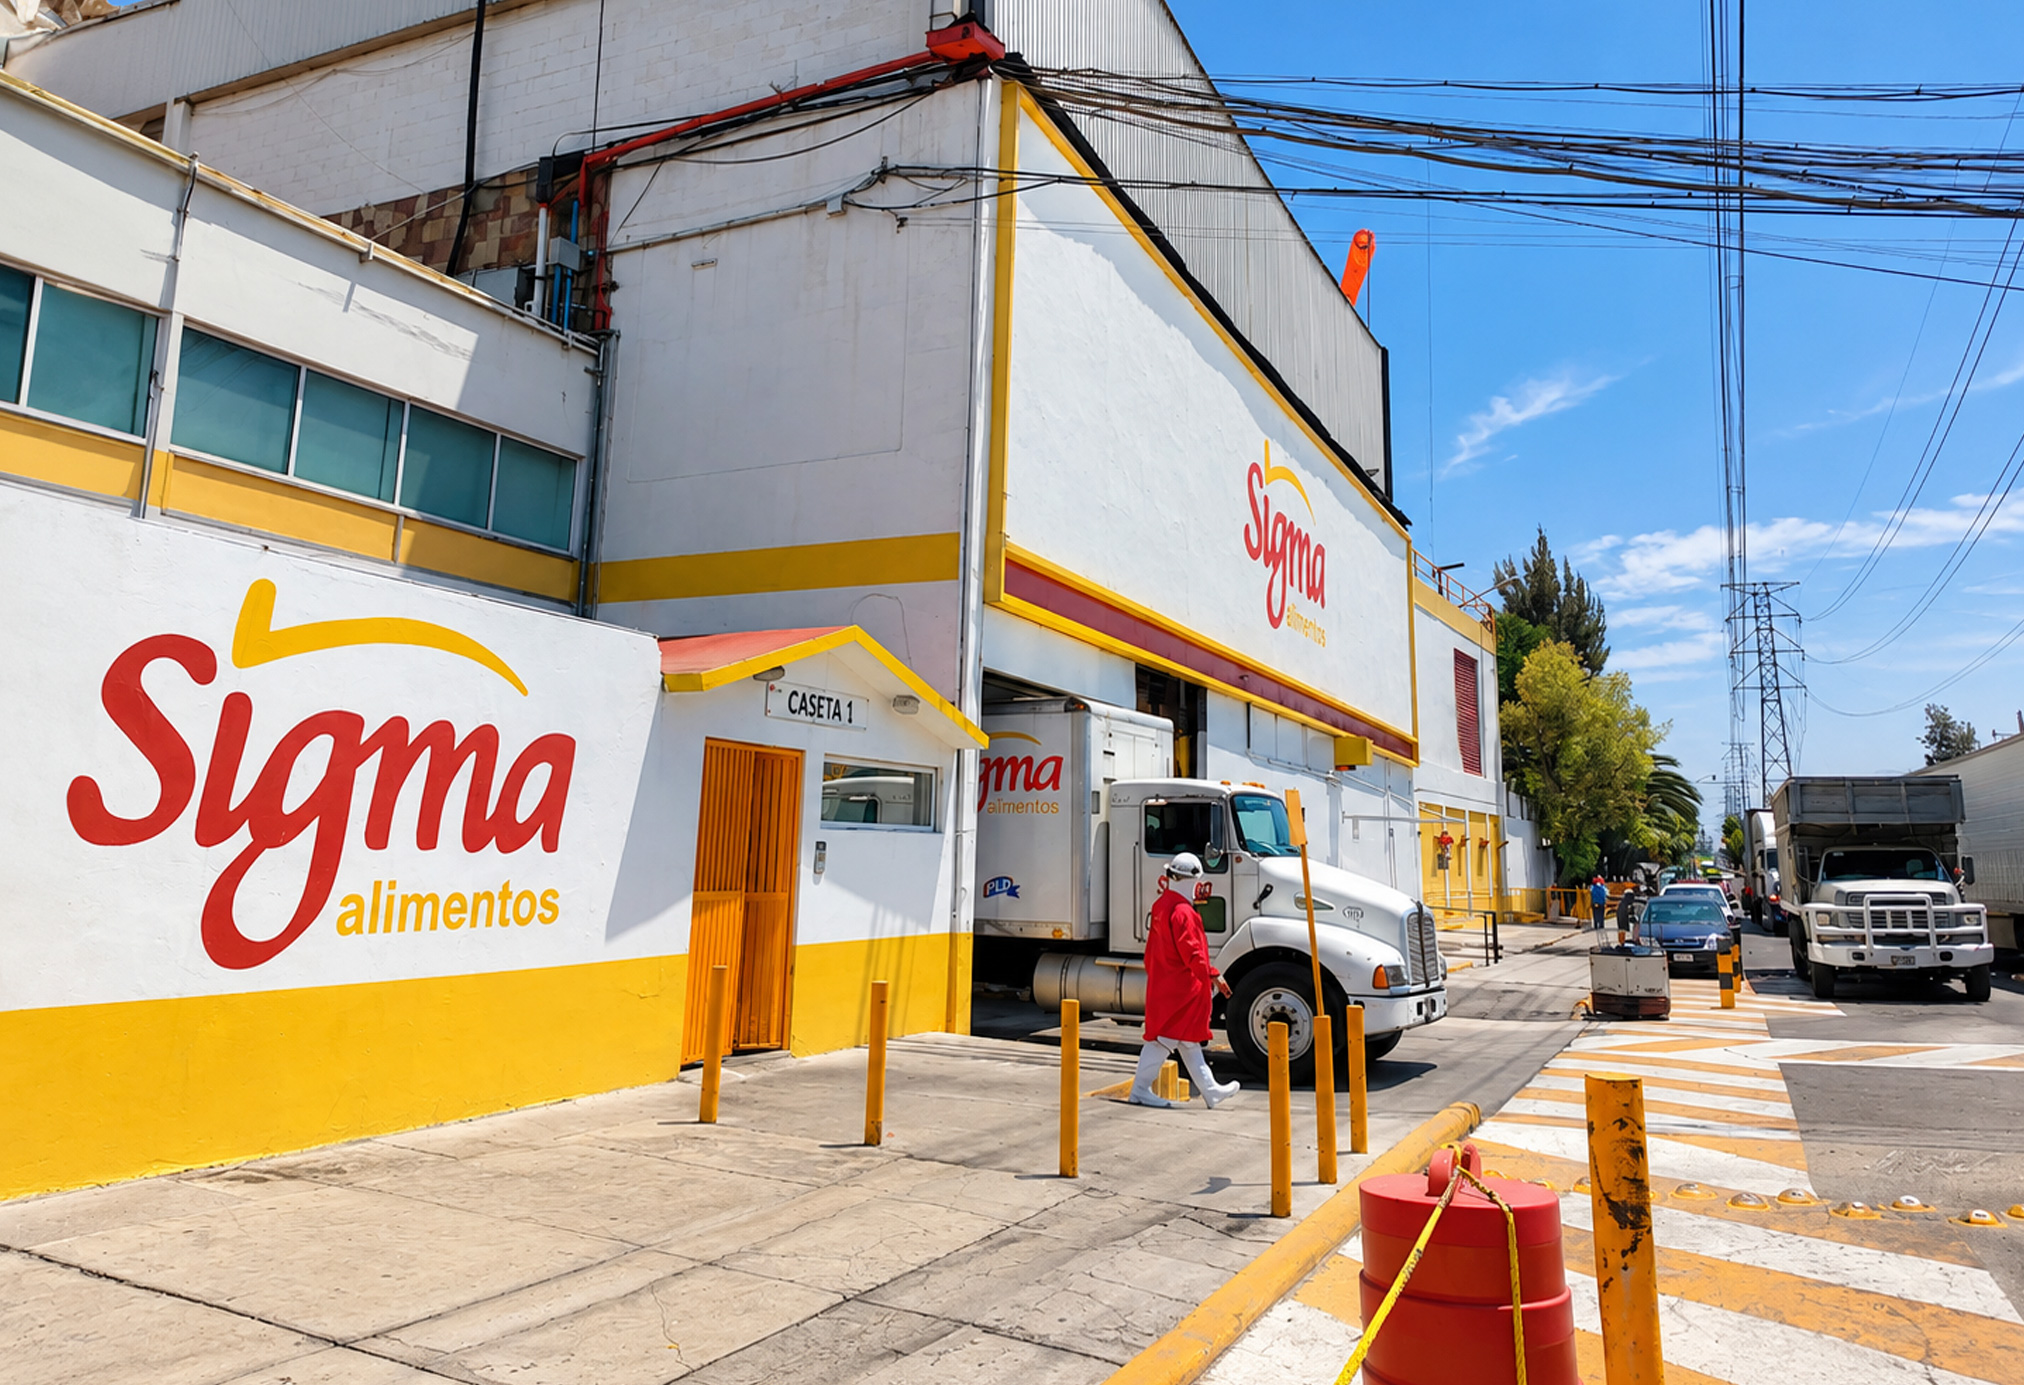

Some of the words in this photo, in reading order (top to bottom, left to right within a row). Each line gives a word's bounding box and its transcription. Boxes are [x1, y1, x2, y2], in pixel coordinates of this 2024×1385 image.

[1244, 462, 1325, 629] Sigma
[788, 690, 842, 722] CASETA
[847, 700, 853, 724] 1
[66, 633, 576, 970] Sigma
[987, 798, 1059, 814] alimentos
[335, 879, 560, 937] alimentos
[987, 878, 1012, 896] PLD
